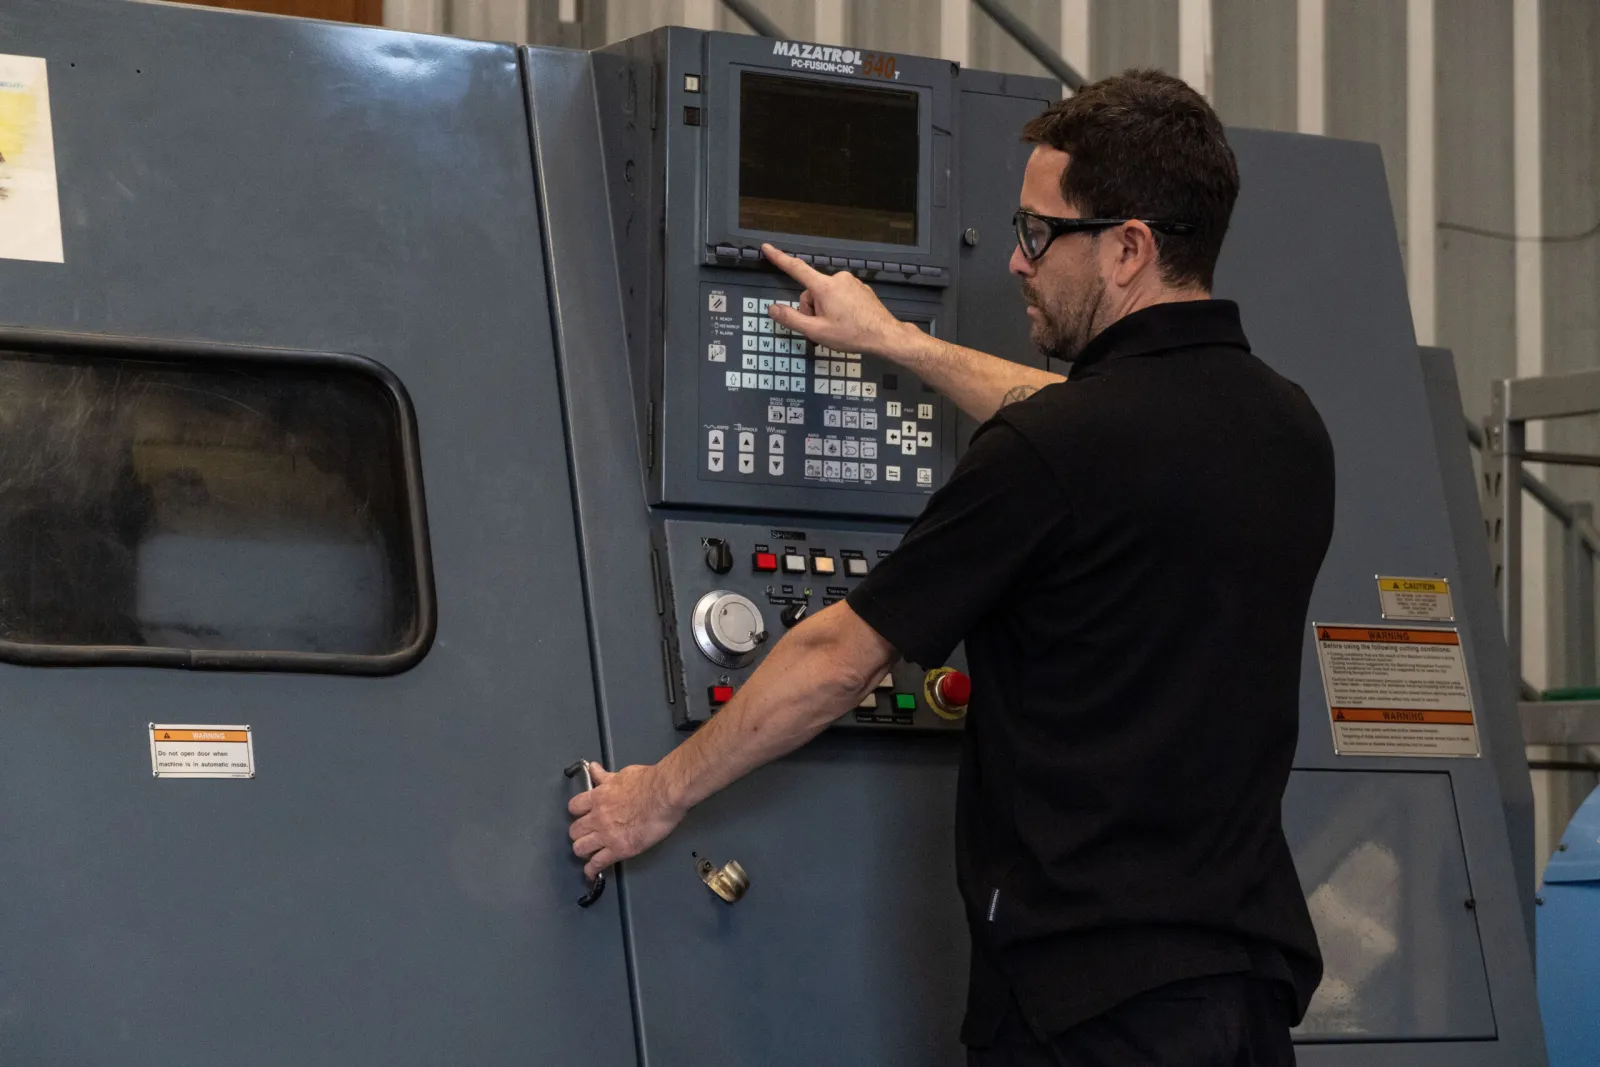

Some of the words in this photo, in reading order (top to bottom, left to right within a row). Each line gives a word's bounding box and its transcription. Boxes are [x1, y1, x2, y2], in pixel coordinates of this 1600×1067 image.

[773, 41, 862, 65] MAZATROL
[791, 59, 854, 74] PC-FUSION-CNC
[702, 538, 710, 547] X
[1403, 581, 1436, 590] CAUTION
[1368, 631, 1410, 641] WARNING
[1382, 711, 1425, 721] WARNING
